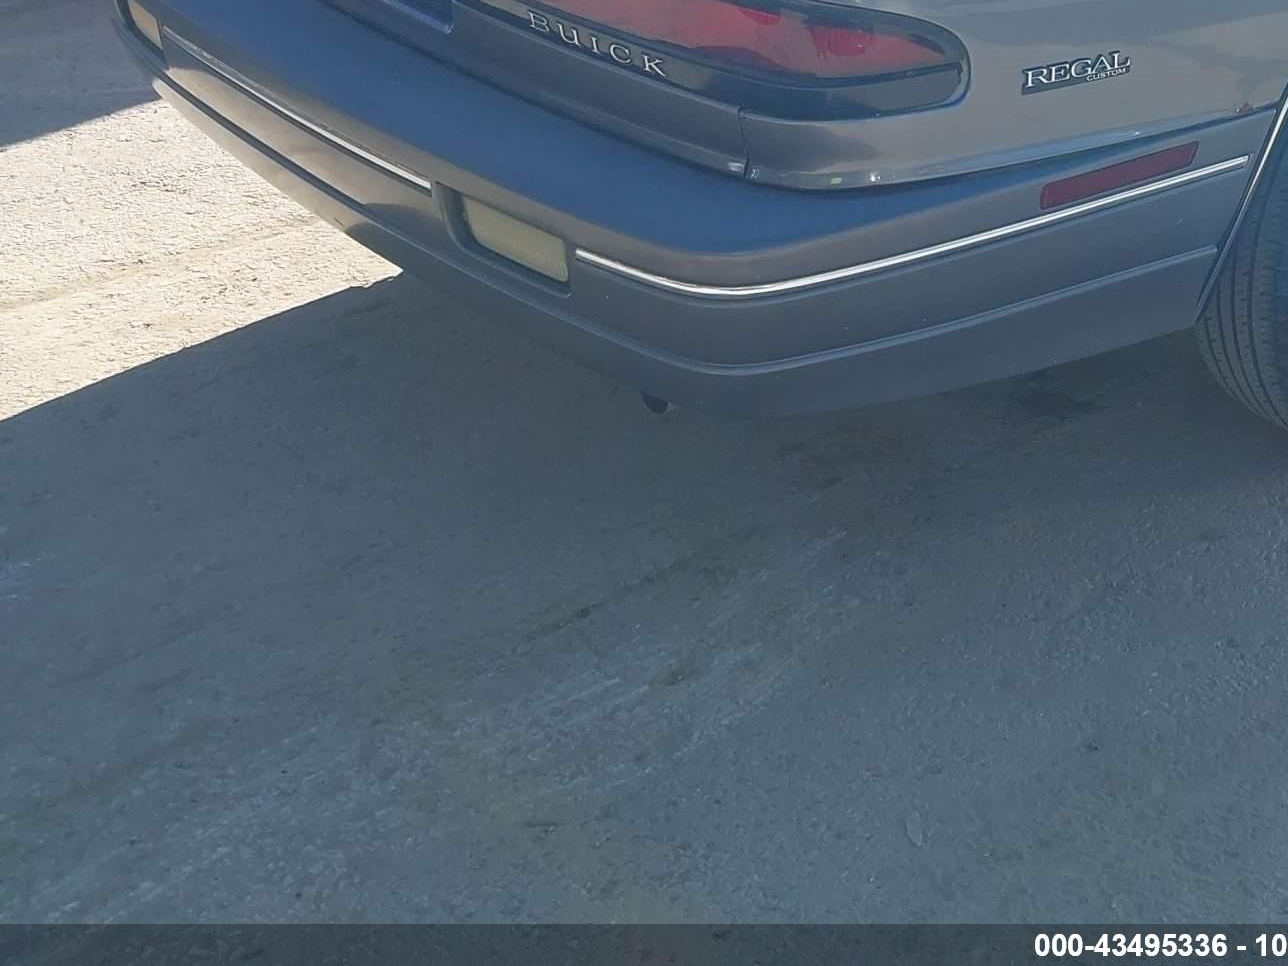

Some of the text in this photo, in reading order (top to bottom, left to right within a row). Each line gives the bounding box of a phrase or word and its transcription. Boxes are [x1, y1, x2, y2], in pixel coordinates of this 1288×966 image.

[527, 10, 667, 78] BUICK
[1023, 51, 1131, 88] REGAL
[1086, 67, 1126, 82] CUSTOM
